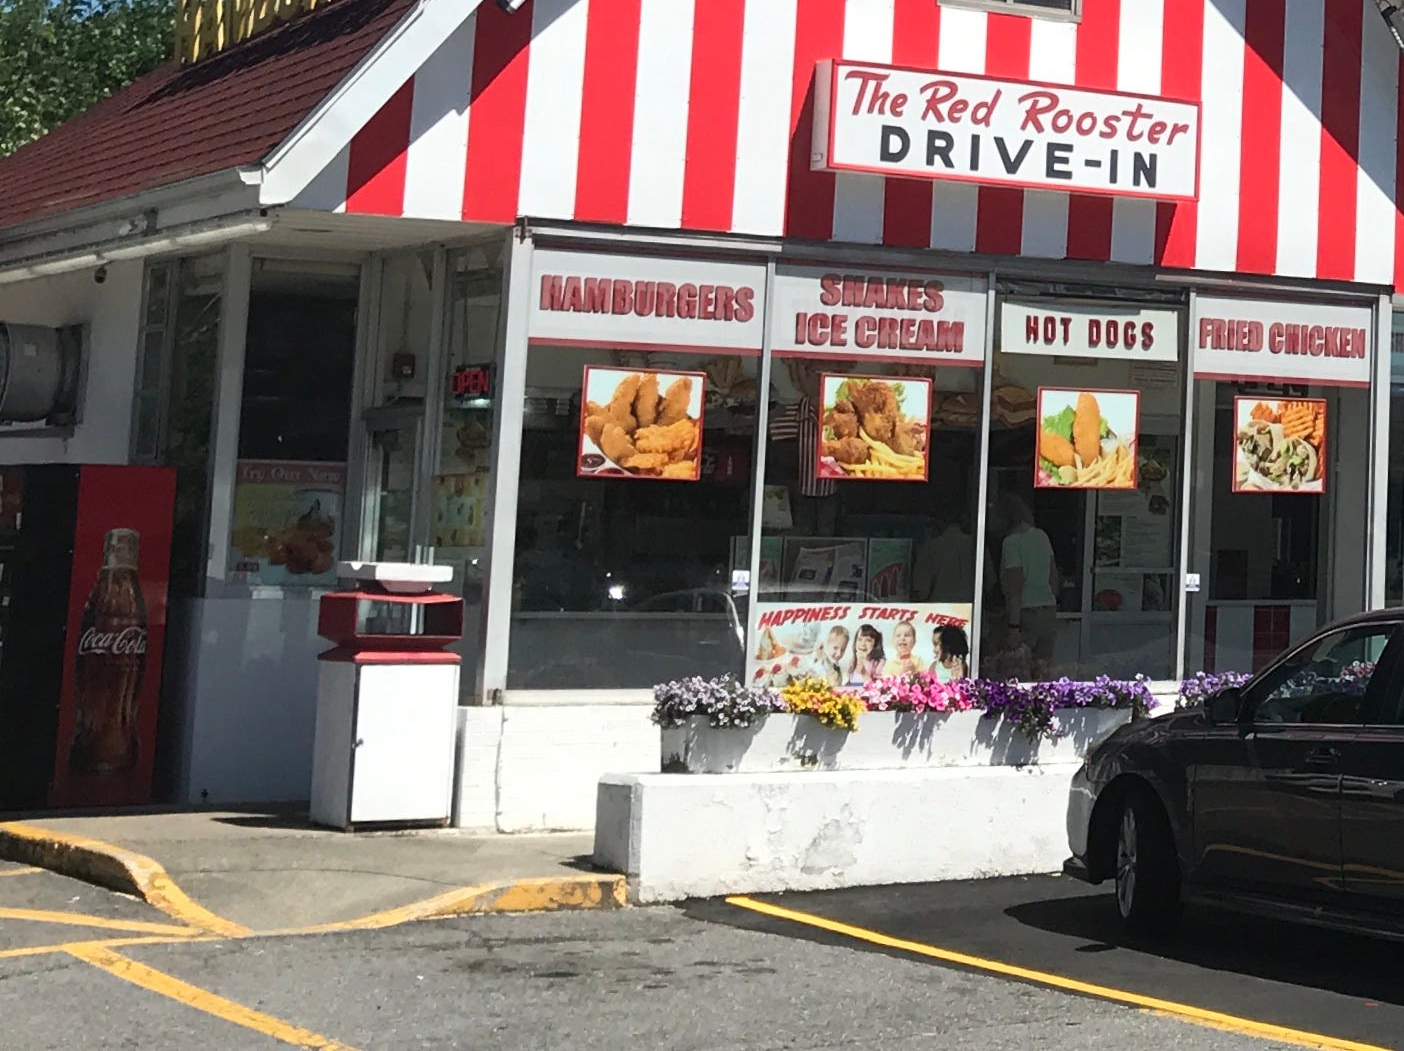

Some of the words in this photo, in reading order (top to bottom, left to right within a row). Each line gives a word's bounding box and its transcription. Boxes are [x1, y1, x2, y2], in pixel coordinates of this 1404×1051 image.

[844, 69, 908, 116] The
[919, 80, 1002, 128] Red
[1018, 91, 1190, 146] Rooster
[879, 124, 1158, 188] DRIVE-IN
[540, 274, 754, 323] HAMBURGERS
[820, 273, 945, 313] SHAKES
[795, 312, 848, 347] ICE
[855, 315, 964, 353] CREAM
[1025, 315, 1072, 345] HOT
[1088, 319, 1155, 350] DOGS
[1199, 318, 1263, 352] FRIED
[1269, 323, 1366, 359] CHICKEN
[450, 369, 490, 395] OPEN
[242, 465, 266, 482] Try
[271, 467, 301, 481] Our
[307, 468, 342, 484] New
[757, 606, 852, 631] HAPPINESS
[858, 606, 920, 622] STARTS
[924, 612, 968, 628] HERE
